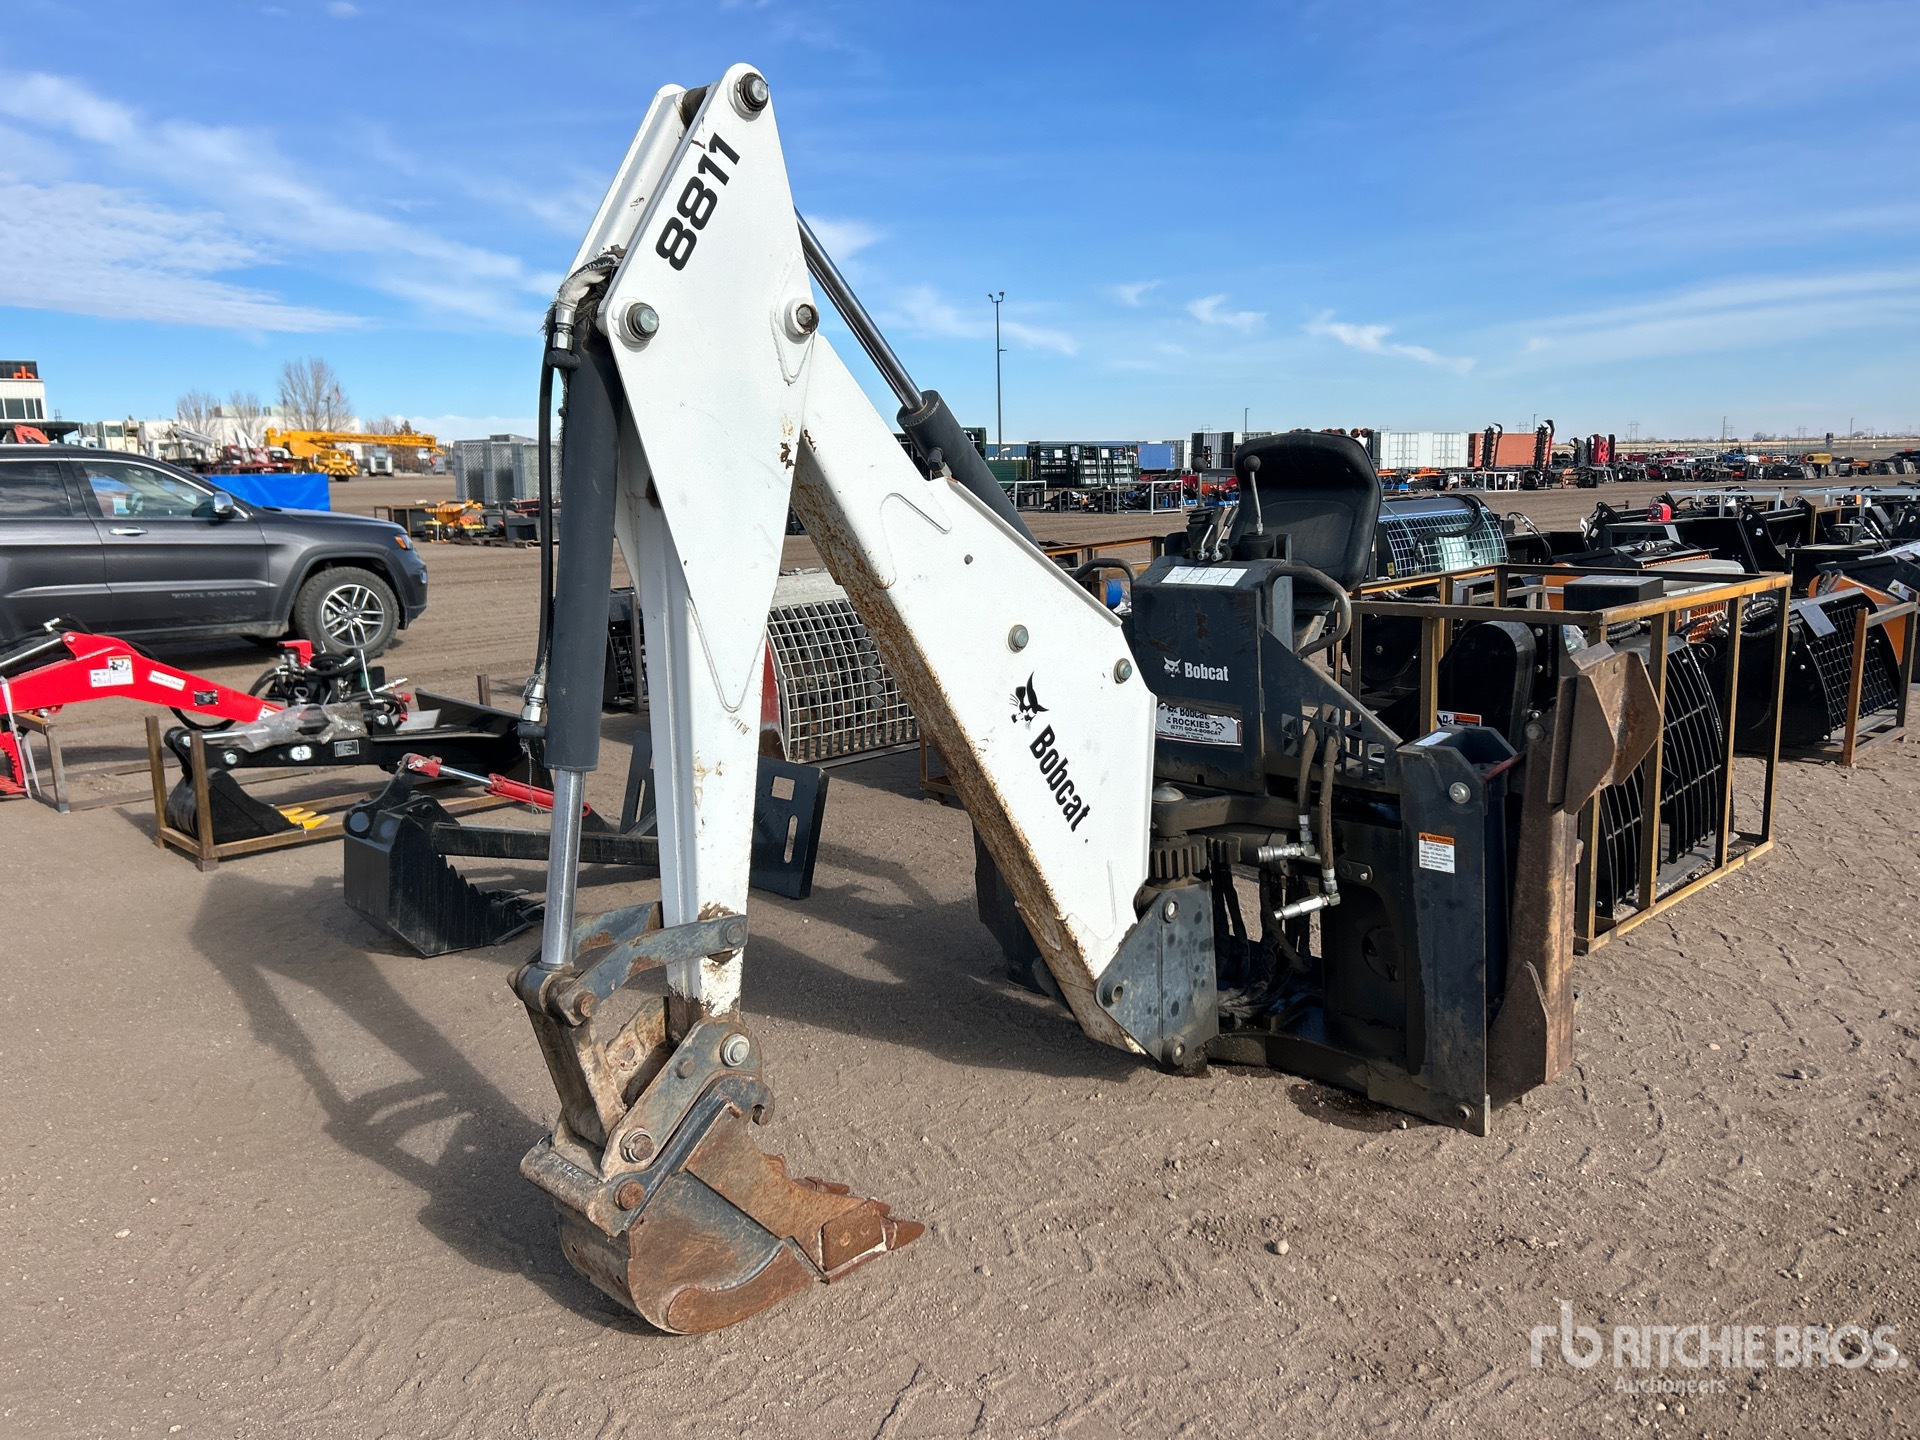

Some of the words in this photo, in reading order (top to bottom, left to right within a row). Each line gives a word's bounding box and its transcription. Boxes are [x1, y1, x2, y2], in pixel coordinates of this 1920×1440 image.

[656, 132, 740, 271] 8811
[1184, 662, 1229, 682] Bobcat
[1172, 717, 1210, 729] ROCKIES
[1029, 724, 1091, 832] Bobcat
